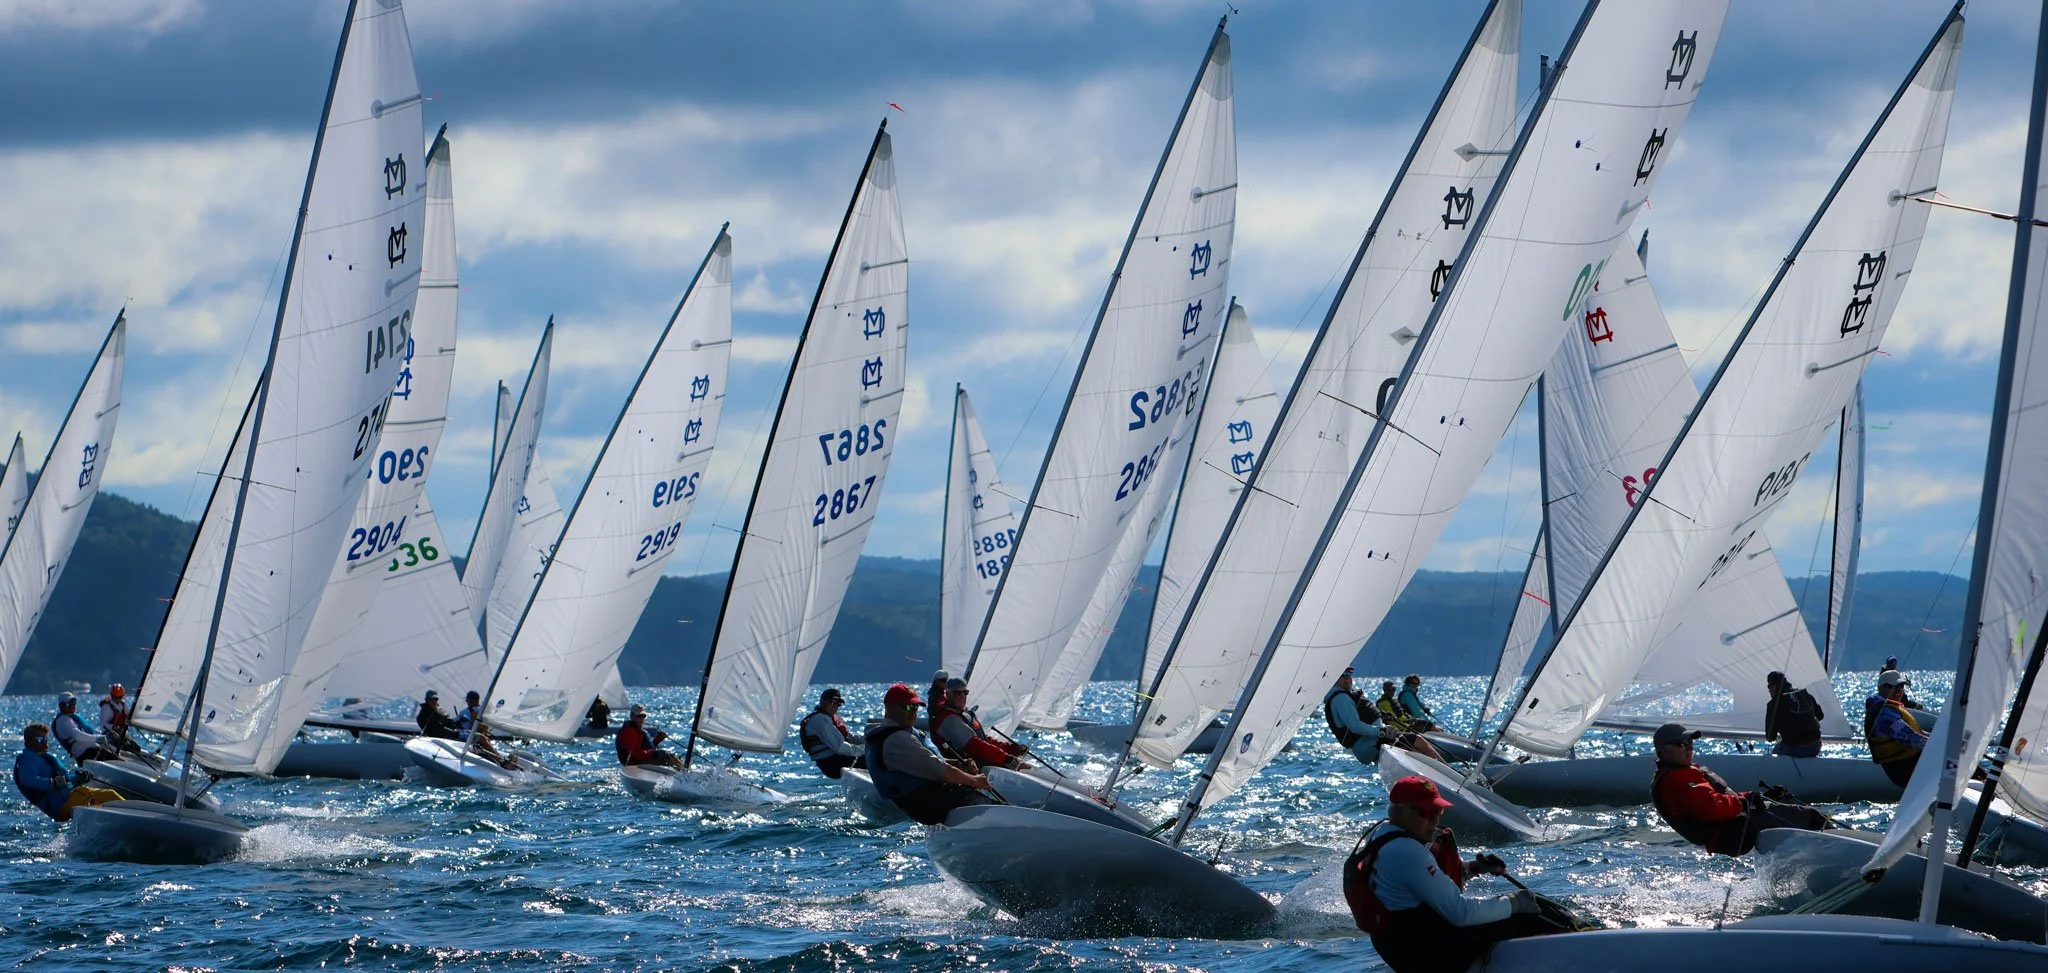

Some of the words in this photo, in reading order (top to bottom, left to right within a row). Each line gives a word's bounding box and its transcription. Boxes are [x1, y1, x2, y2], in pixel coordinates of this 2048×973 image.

[812, 475, 876, 527] 2867
[346, 515, 407, 562] 2904
[636, 521, 682, 562] 2919
